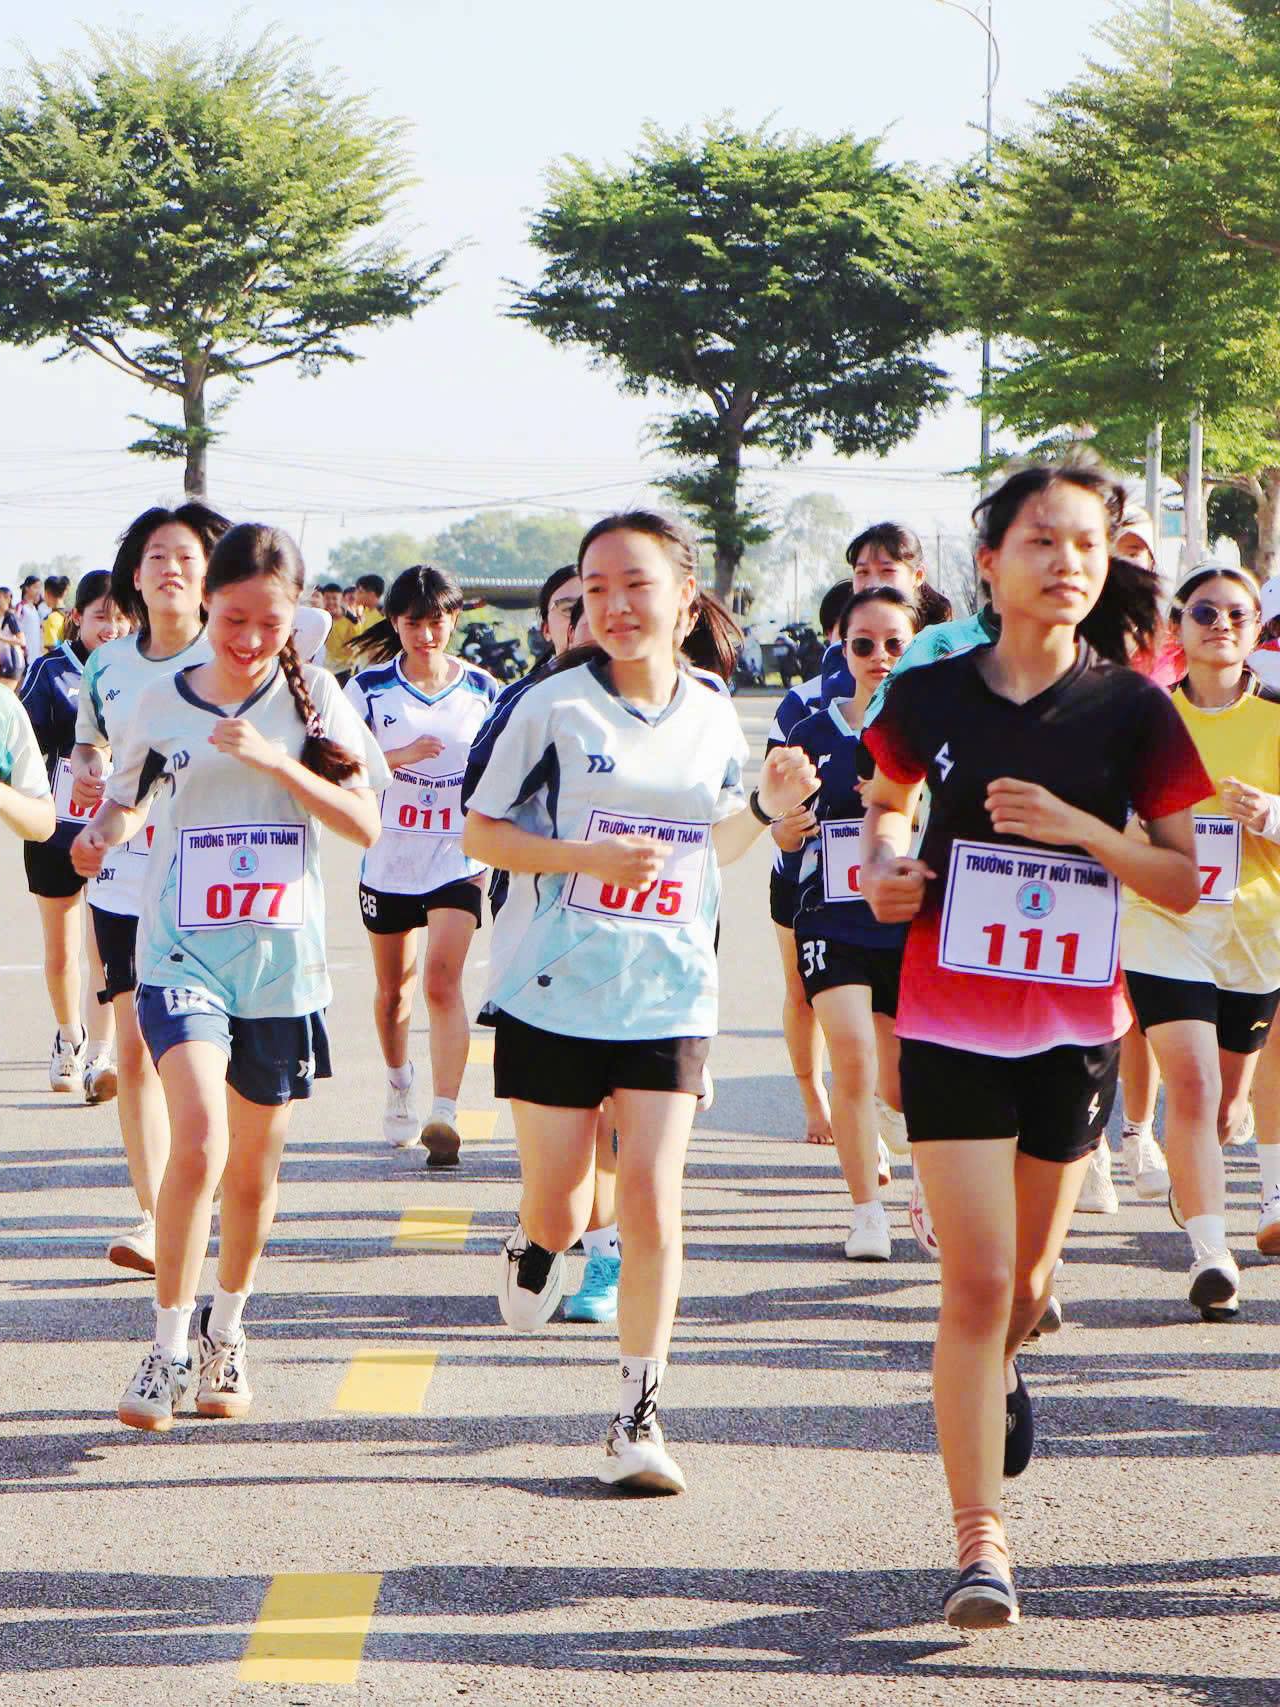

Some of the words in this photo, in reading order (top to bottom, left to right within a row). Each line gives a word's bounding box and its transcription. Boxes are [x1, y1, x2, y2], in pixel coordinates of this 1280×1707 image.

[399, 804, 451, 830] 011
[830, 825, 860, 838] TRƯỜNG
[189, 832, 224, 849] TRƯỜNG
[226, 832, 248, 846] THPT
[250, 829, 268, 845] NÚI
[270, 829, 299, 845] THÀNH
[657, 825, 675, 841] NÚI
[677, 826, 704, 843] THÀNH
[966, 853, 1013, 876] TRƯỜNG
[1017, 861, 1047, 880] THPT
[1049, 863, 1071, 883] NÚI
[1074, 866, 1108, 888] THÀNH
[206, 883, 288, 919] 077
[599, 879, 683, 916] 075
[982, 923, 1080, 975] 111
